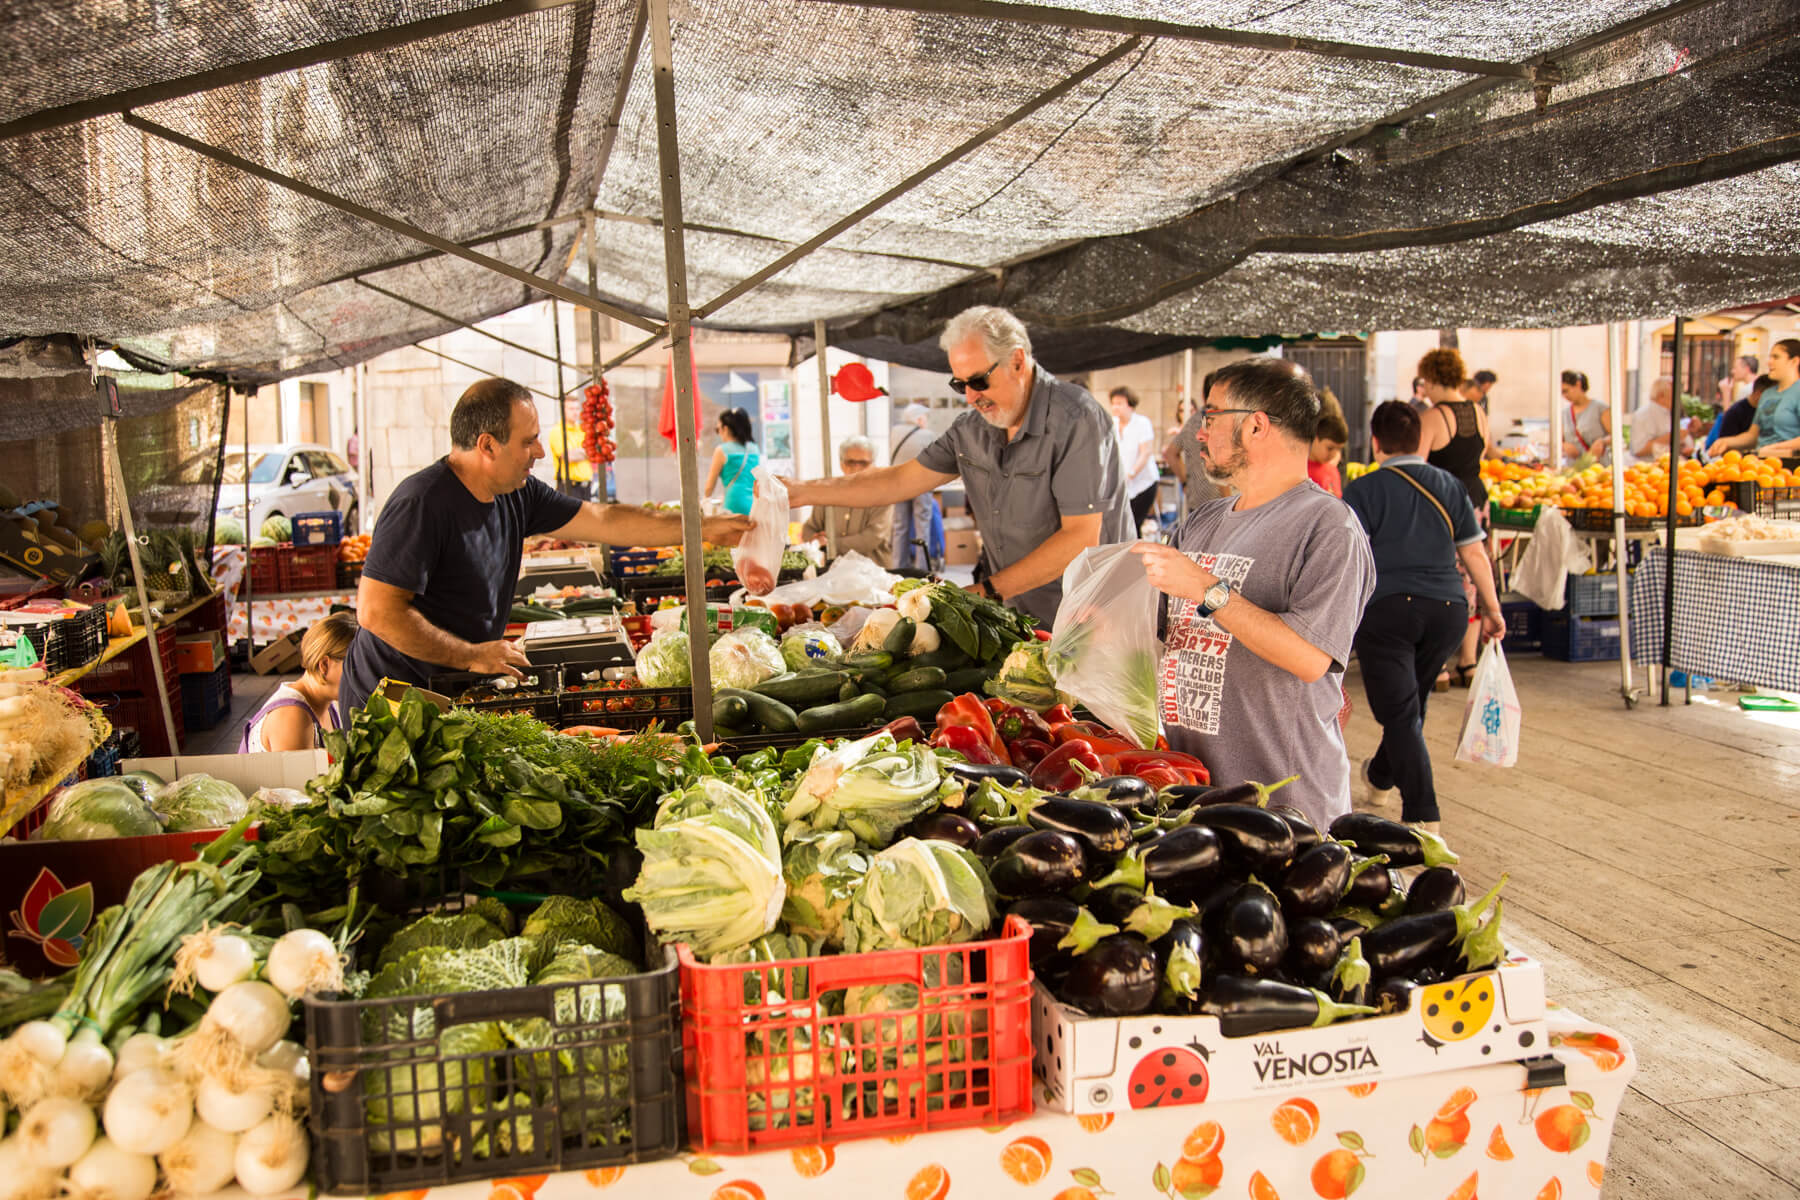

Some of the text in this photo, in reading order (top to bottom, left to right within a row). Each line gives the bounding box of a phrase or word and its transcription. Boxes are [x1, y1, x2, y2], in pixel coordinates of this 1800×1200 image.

[1191, 667, 1222, 685] CLUB
[1165, 658, 1179, 723] BOLTON
[1176, 686, 1212, 710] 1877
[1253, 1040, 1284, 1057] VAL
[1253, 1045, 1380, 1083] VENOSTA
